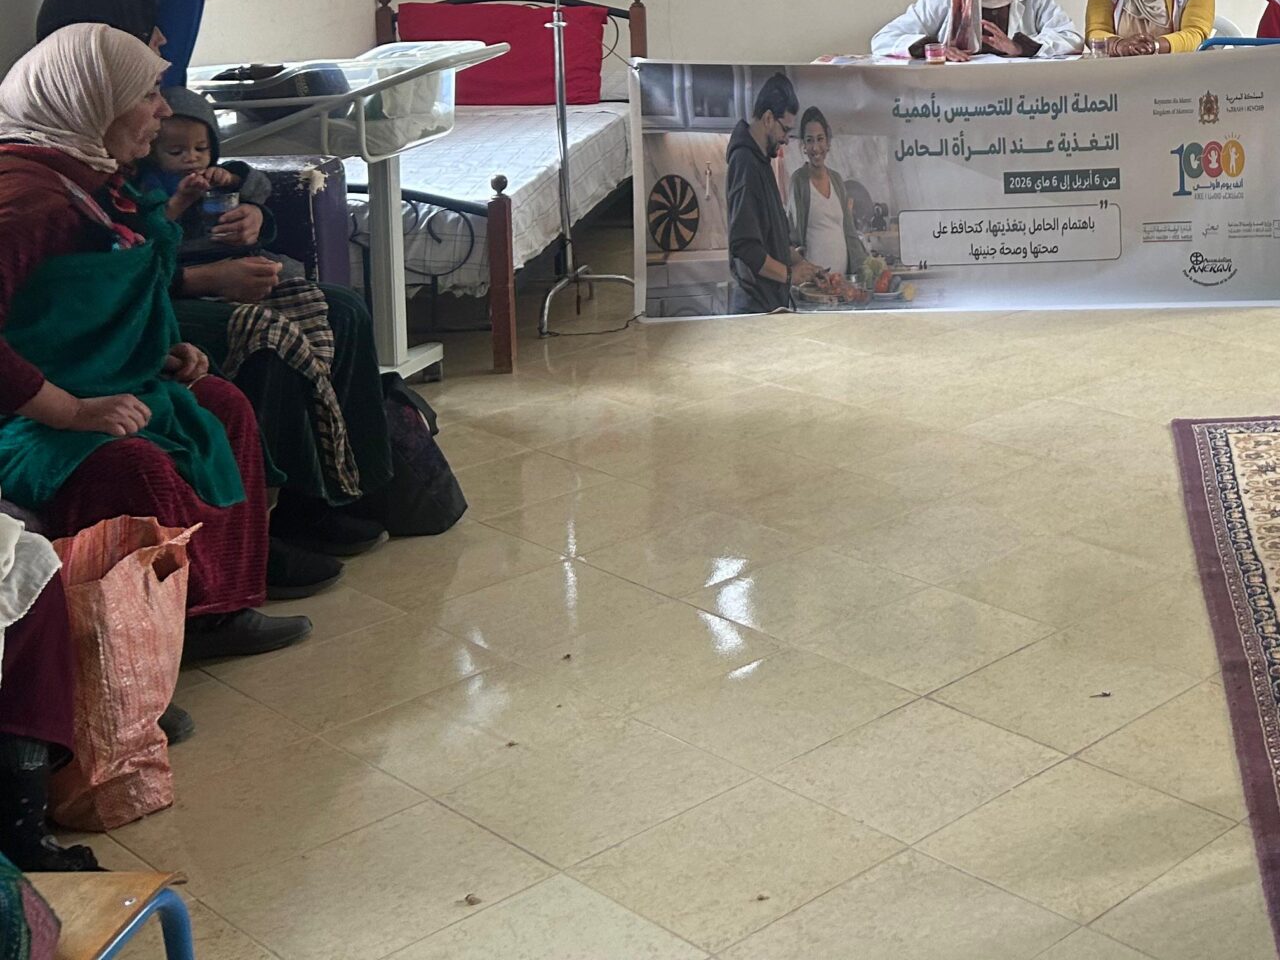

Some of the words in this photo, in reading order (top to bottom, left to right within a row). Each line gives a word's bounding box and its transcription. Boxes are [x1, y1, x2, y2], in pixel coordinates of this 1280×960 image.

[892, 92, 940, 123] بأهمية
[944, 97, 1013, 123] للتحسيس
[1016, 95, 1068, 120] الوطنية
[1072, 93, 1118, 113] الحملة
[1009, 177, 1032, 188] 2026
[1034, 178, 1050, 193] ماي
[1052, 177, 1058, 186] 6
[1060, 175, 1070, 190] إلى
[1072, 169, 1093, 189] أبريل
[1094, 174, 1100, 185] 6
[1102, 175, 1117, 188] من
[932, 222, 948, 238] على
[950, 219, 984, 235] كتحافظ
[1028, 217, 1059, 235] الحامل
[1061, 216, 1095, 236] باهتمام
[999, 241, 1028, 259] وصحة
[1029, 242, 1059, 255] صحتها
